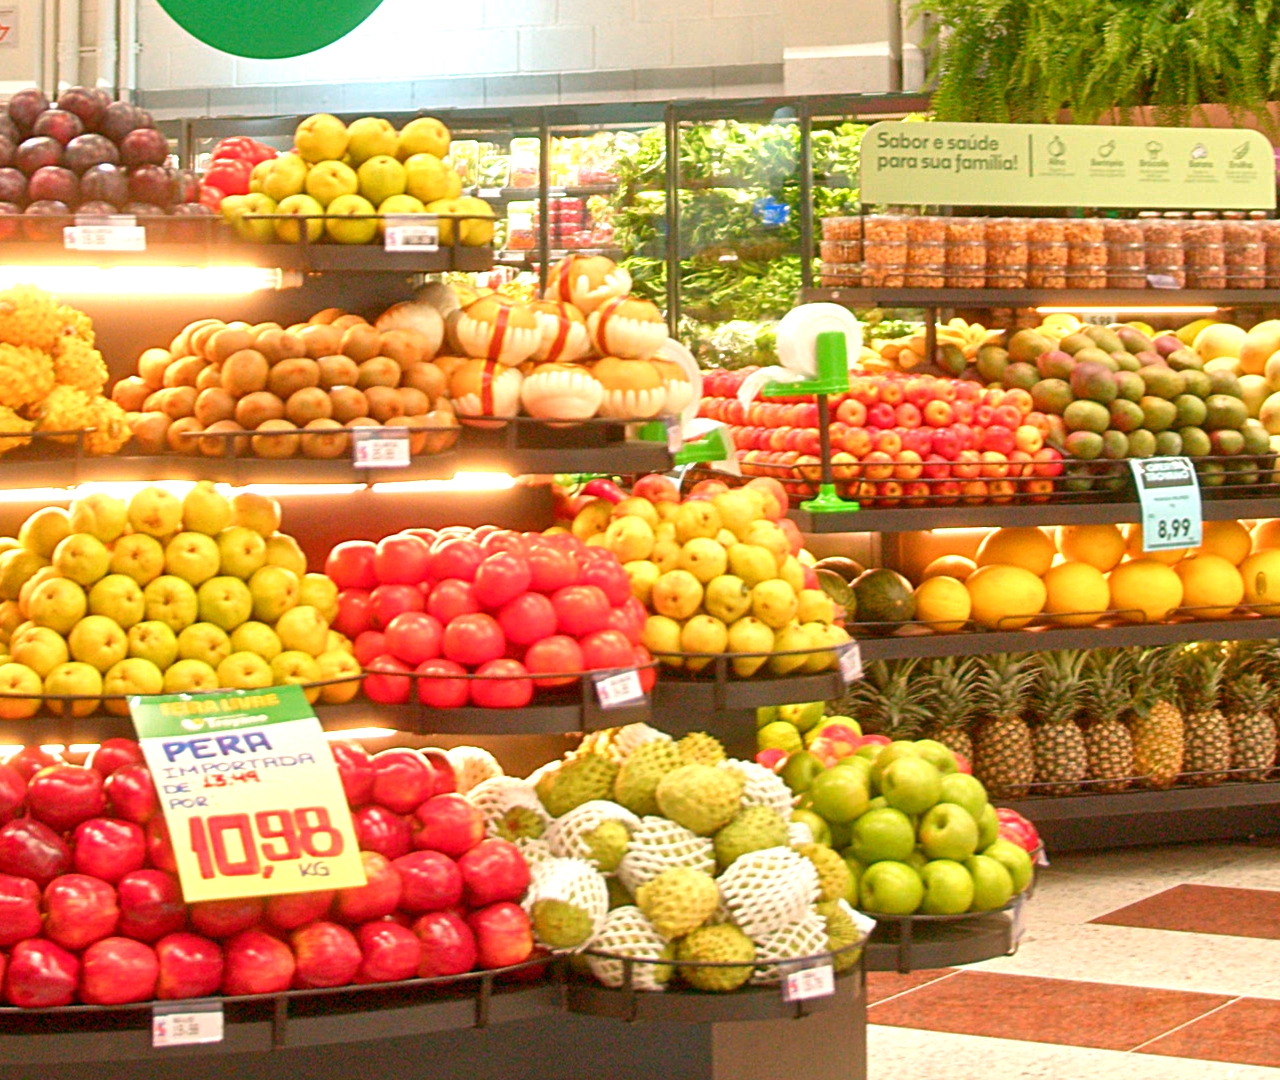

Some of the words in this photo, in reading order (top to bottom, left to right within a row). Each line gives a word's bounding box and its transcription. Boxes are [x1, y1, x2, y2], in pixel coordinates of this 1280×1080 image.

[877, 132, 929, 149] Sabor
[933, 138, 943, 149] e
[947, 134, 999, 150] saúde
[877, 156, 917, 171] para
[921, 157, 952, 169] sua
[1158, 518, 1191, 541] 8,99
[159, 700, 219, 716] FEIRA
[220, 693, 280, 712] LIVRE
[162, 731, 273, 762] PERA
[162, 753, 316, 779] IMPORTADA
[188, 806, 344, 880] 10,98
[298, 861, 330, 877] KG
